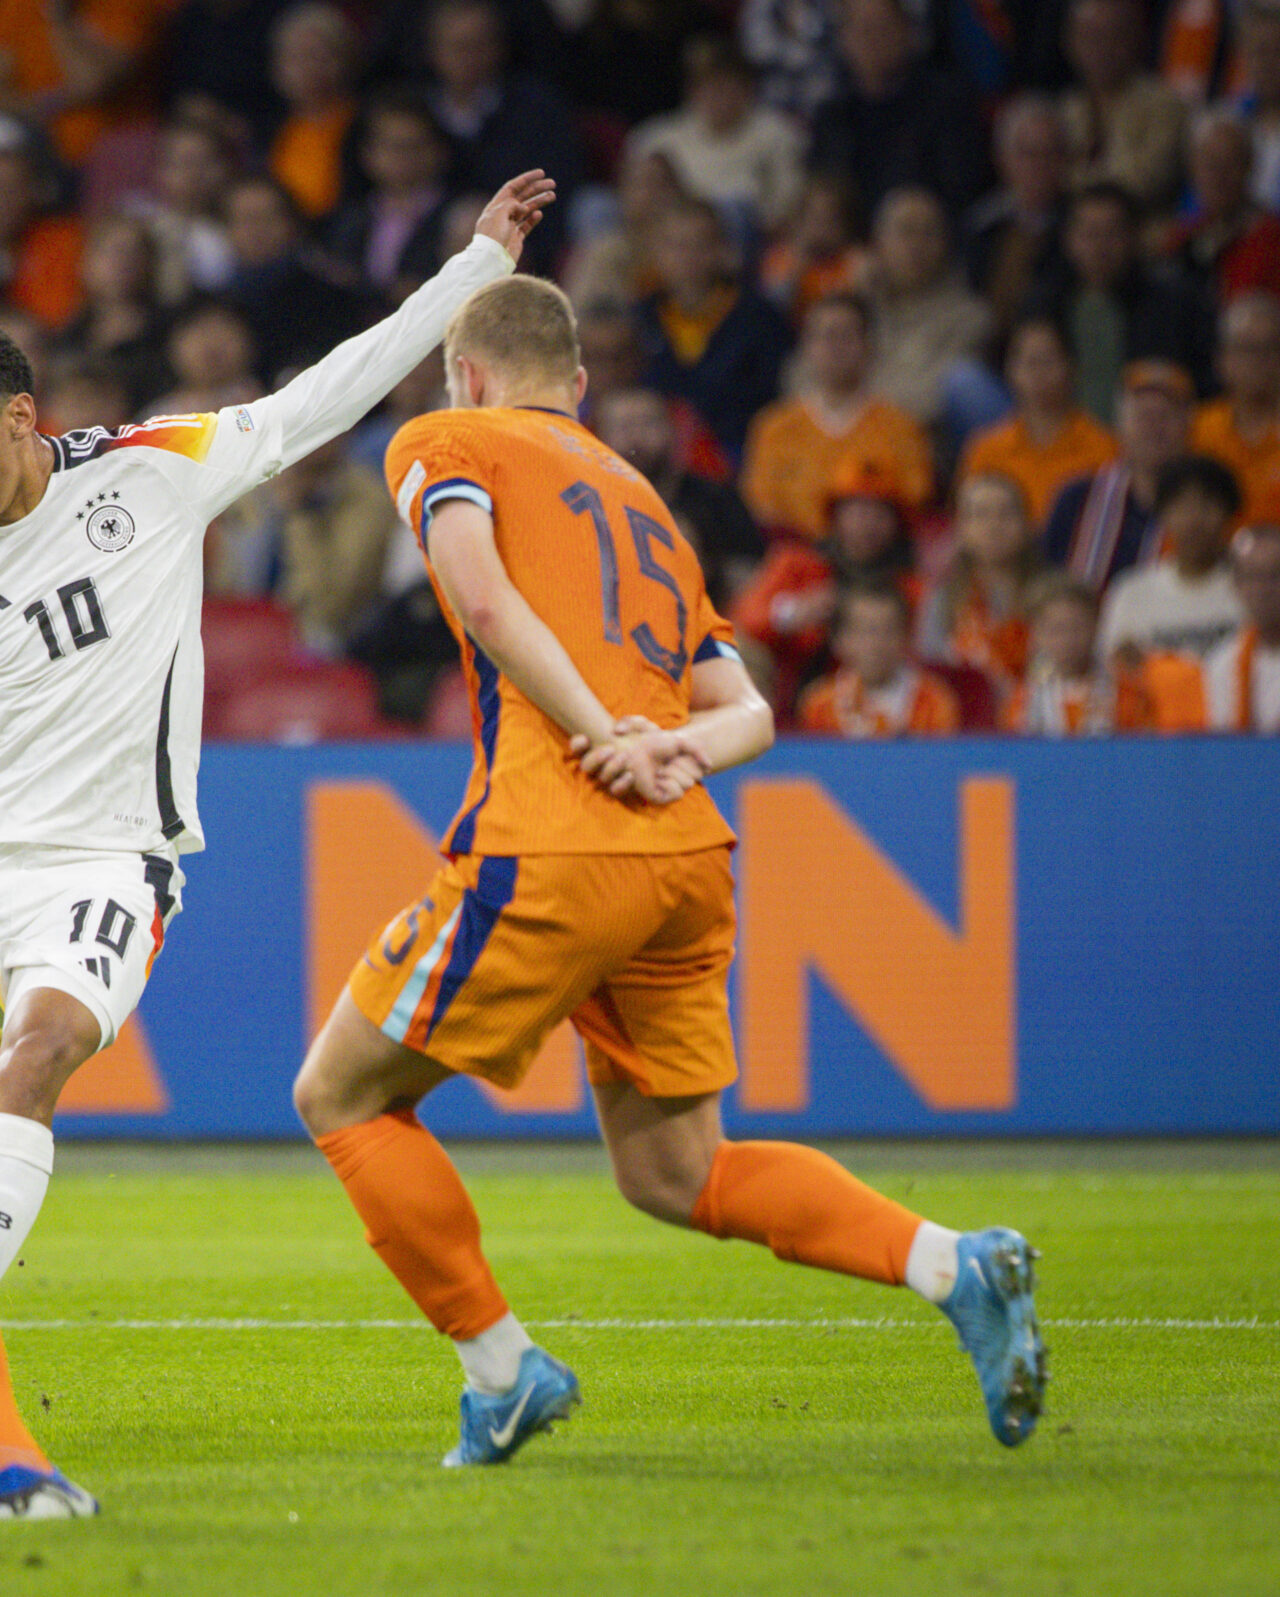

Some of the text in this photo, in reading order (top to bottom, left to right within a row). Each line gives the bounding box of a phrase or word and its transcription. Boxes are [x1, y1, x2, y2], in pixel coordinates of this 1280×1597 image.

[23, 576, 113, 661] 10
[559, 480, 689, 684] 15
[69, 897, 137, 965] 10
